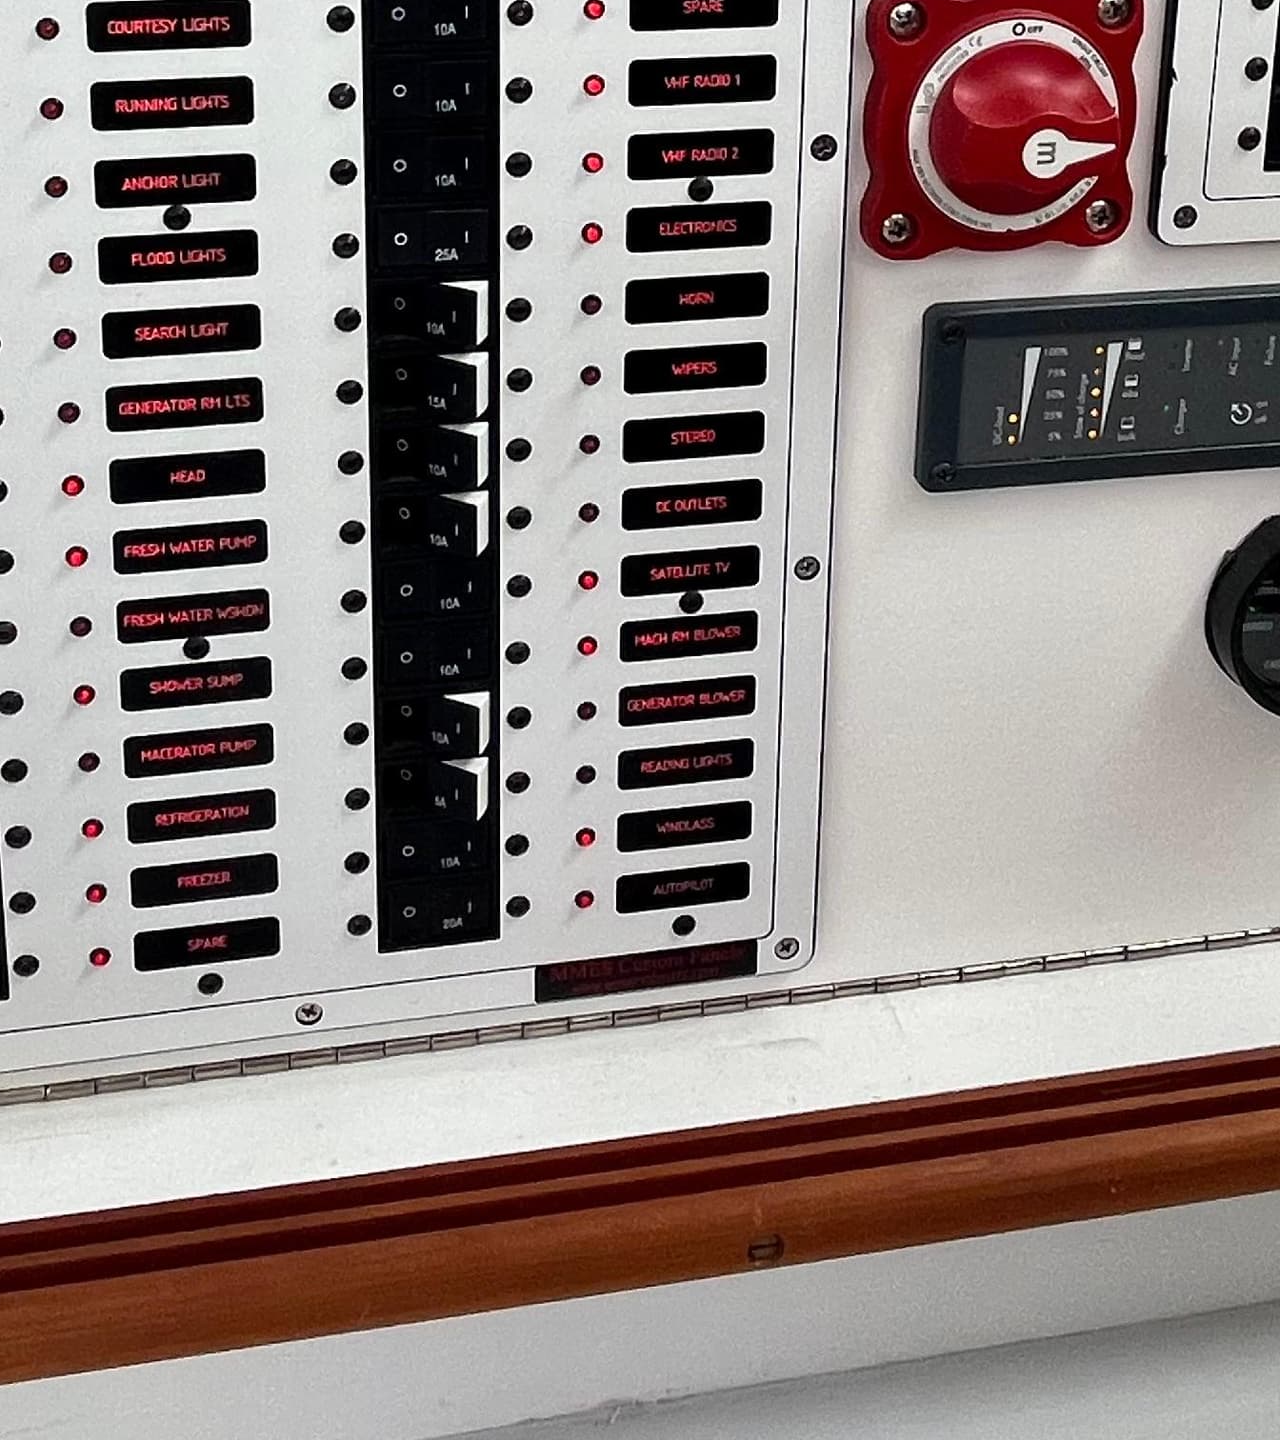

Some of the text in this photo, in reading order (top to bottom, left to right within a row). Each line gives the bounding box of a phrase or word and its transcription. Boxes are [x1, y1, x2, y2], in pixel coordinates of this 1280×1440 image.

[683, 0, 723, 13] SPARE
[108, 17, 230, 34] COURTESY LIGHTS
[435, 23, 456, 35] 10A
[665, 76, 689, 88] VHF
[694, 74, 731, 87] RADIO
[115, 95, 229, 112] RUNNING LIGHTS
[436, 99, 456, 111] 10A
[662, 150, 685, 163] VHF
[692, 148, 727, 161] RADIO
[122, 173, 220, 190] ANCHOR LIGHT
[435, 174, 456, 186] 10A
[660, 220, 736, 235] ELECTRONICS
[132, 248, 226, 266] FLOOD LIGHTS
[435, 248, 458, 261] 25A
[680, 292, 714, 304] HORN
[135, 323, 228, 341] SEARCH LIGHT
[672, 362, 717, 375] WIPERS
[119, 394, 250, 415] GENERATOR RM LTS
[671, 429, 715, 445] STEREO
[171, 470, 205, 483] HEAD
[656, 496, 726, 513] DC OUTLETS
[124, 535, 256, 557] FRESH WATER PUMP
[650, 562, 730, 580] SATELLITE TV
[124, 613, 164, 626] FRESH
[168, 609, 212, 623] WATER
[635, 626, 740, 645] MACH RM BLOWER
[150, 673, 243, 694] SHOWER SUMP
[627, 690, 745, 711] GENERATOR BLOWER
[141, 740, 256, 761] MACERATOR PUMP
[641, 753, 732, 773] READING LIGHTS
[155, 806, 249, 825] REFRIGERATION
[657, 817, 714, 833] WINDLASS
[177, 872, 231, 887] FREEZER
[653, 878, 713, 895] AUTOPILOT
[188, 935, 226, 951] SPARE
